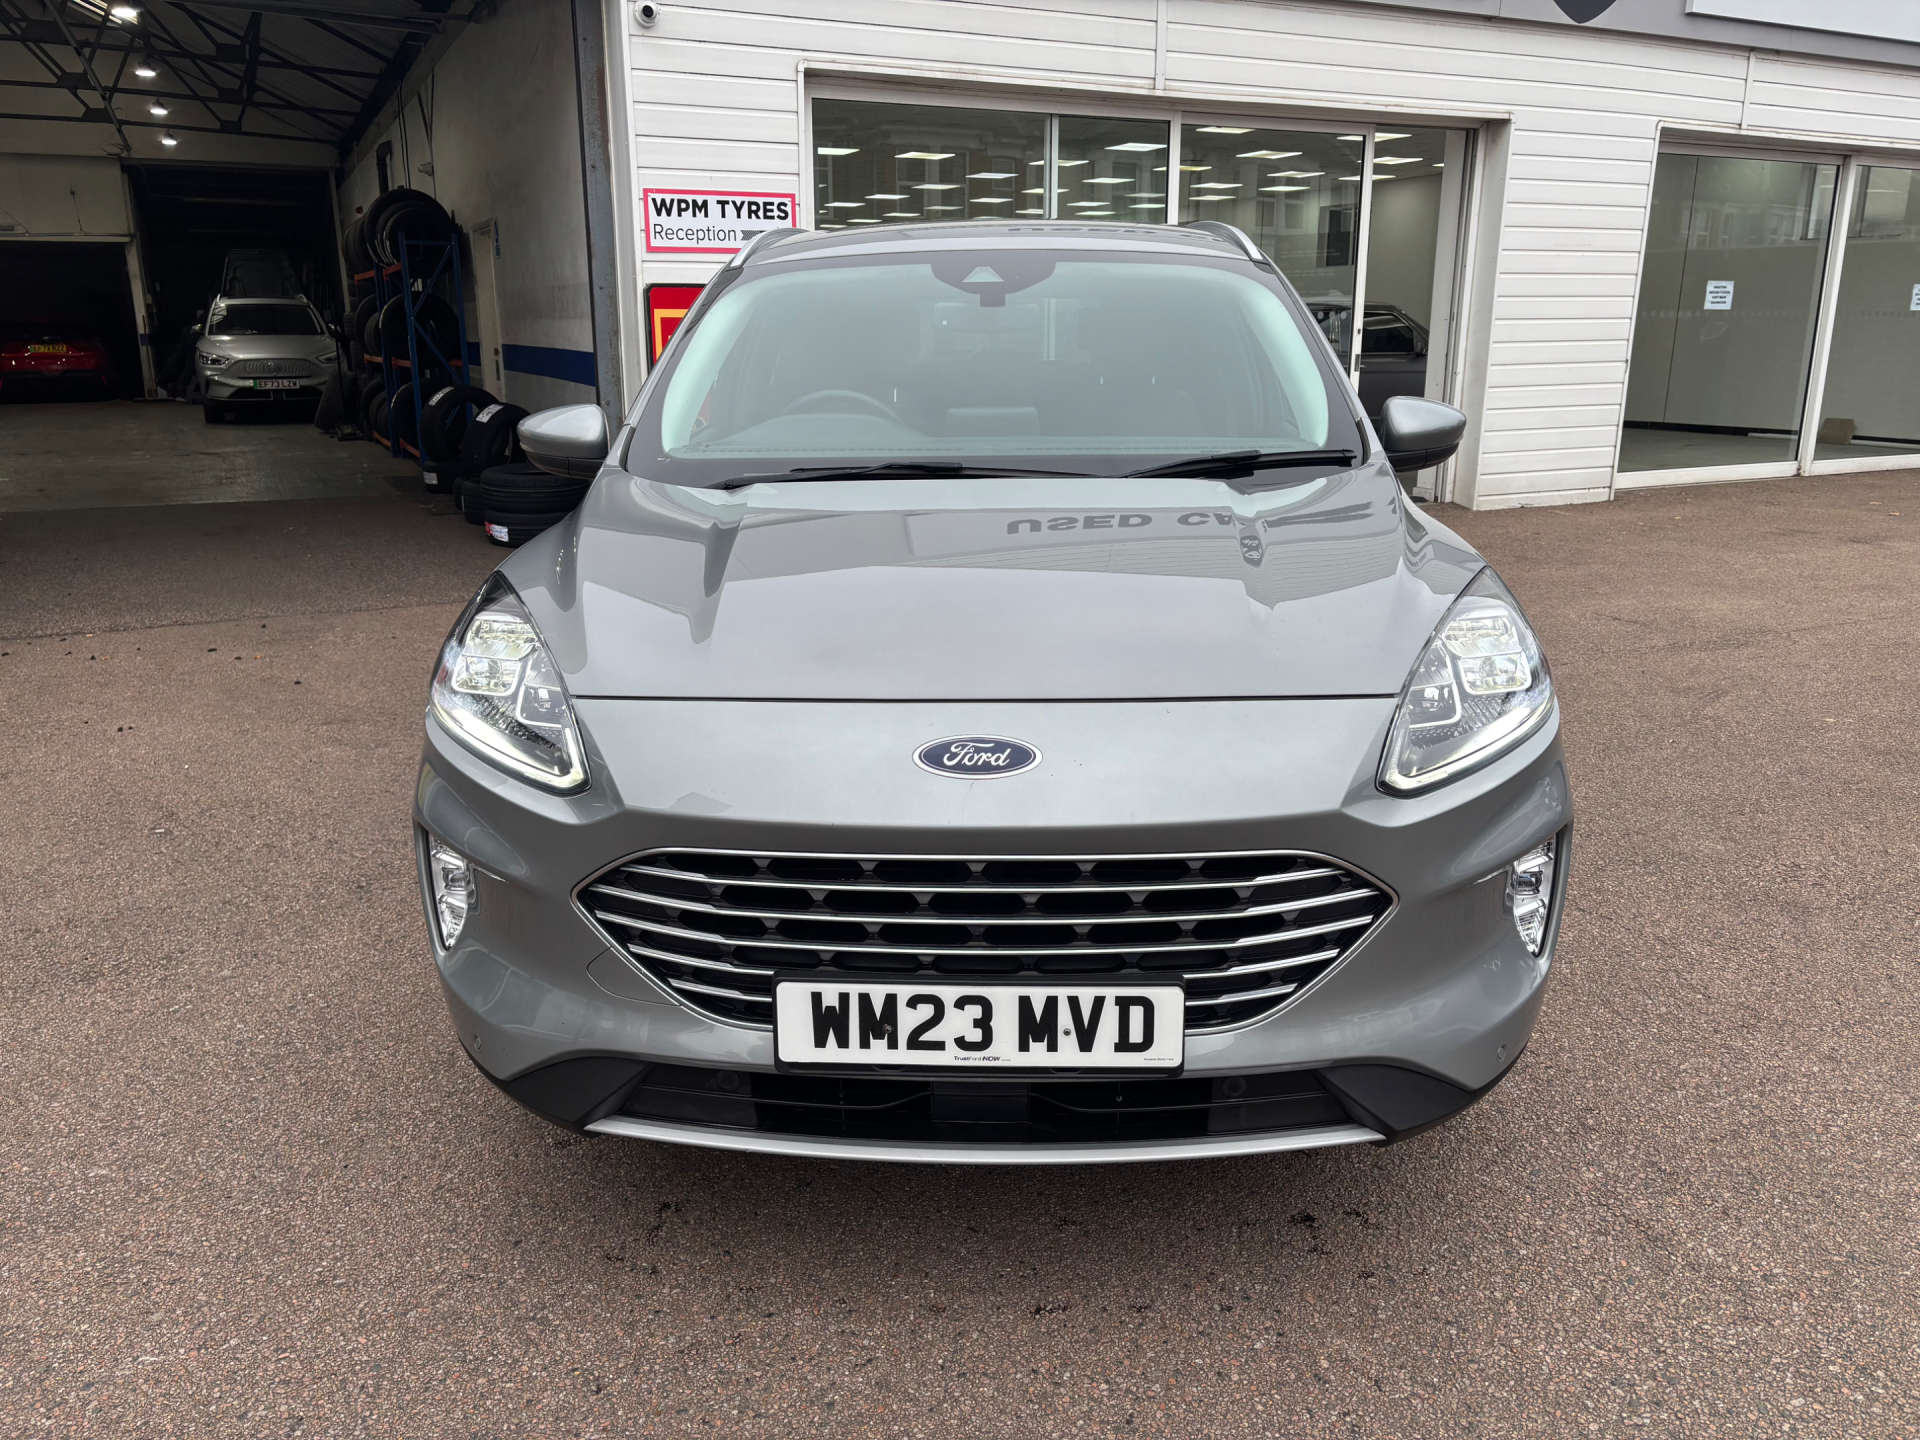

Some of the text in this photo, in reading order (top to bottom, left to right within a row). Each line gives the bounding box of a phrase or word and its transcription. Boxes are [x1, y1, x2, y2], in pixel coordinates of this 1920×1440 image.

[652, 197, 789, 220] WPM TYRES
[653, 224, 736, 244] Reception
[943, 742, 1011, 766] Ford
[811, 992, 1155, 1053] WM23 MVD
